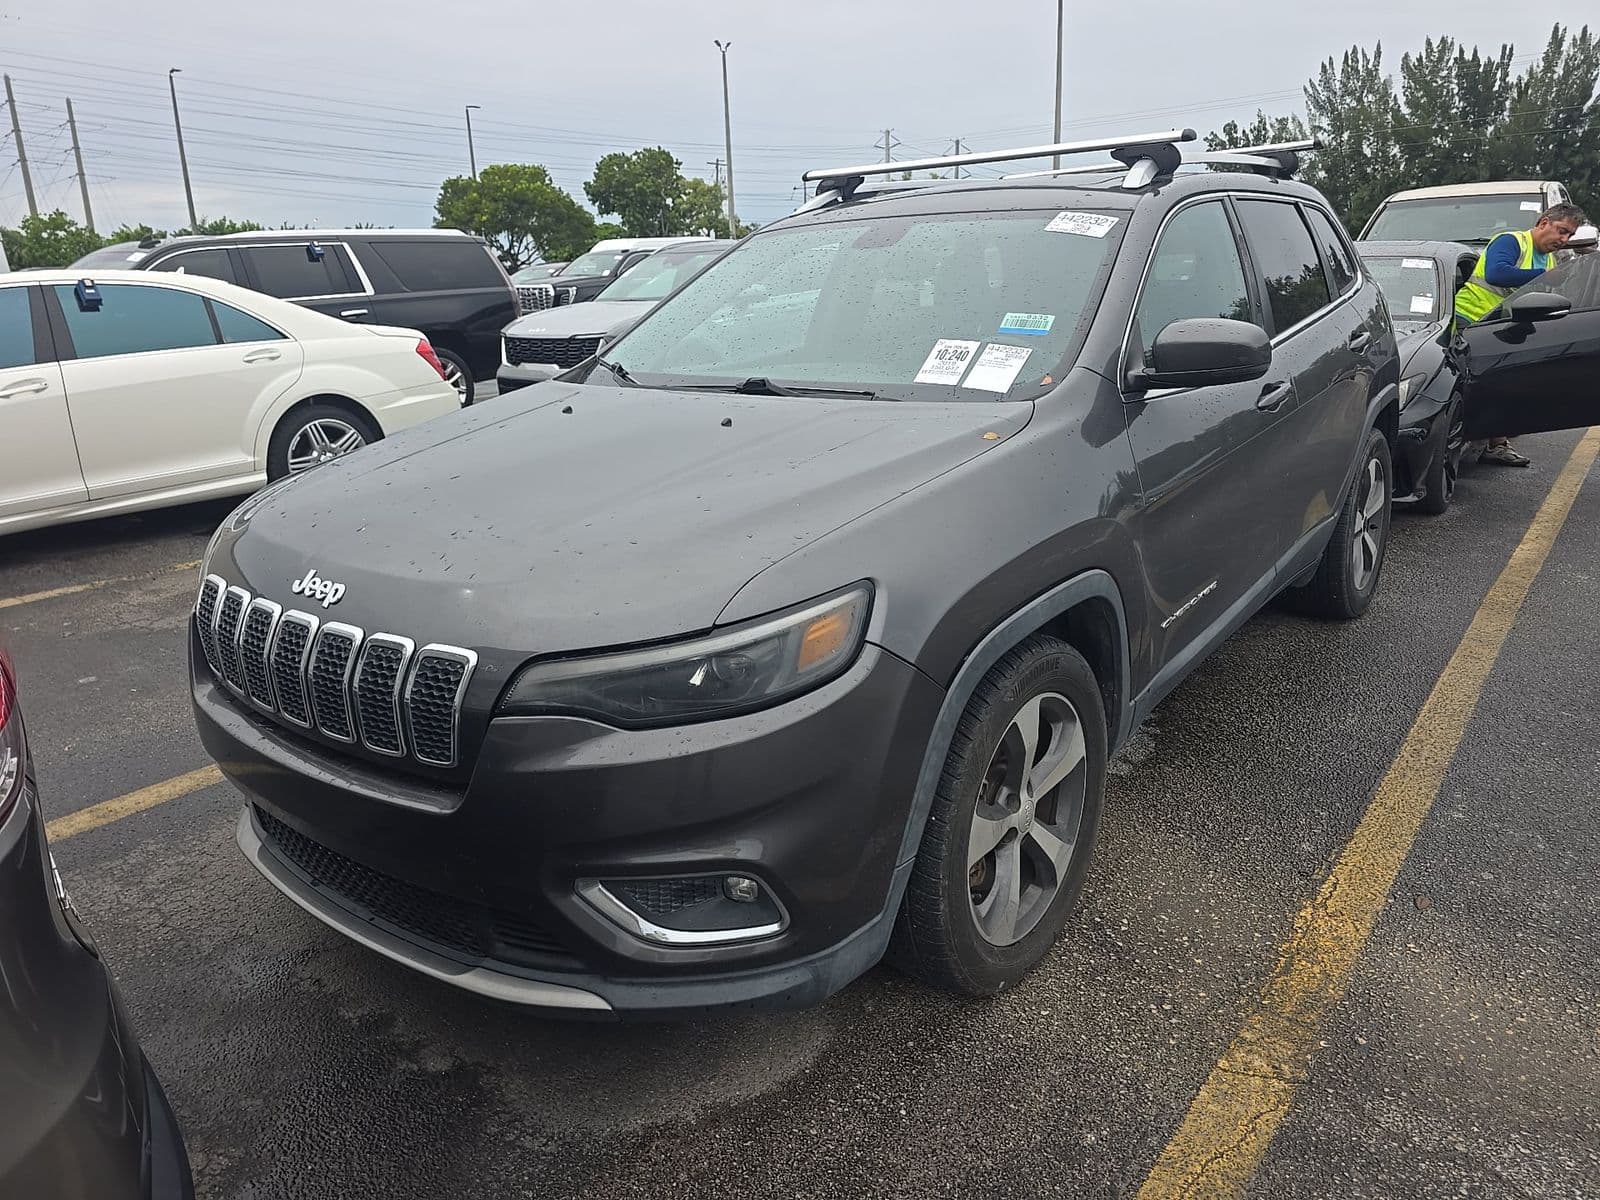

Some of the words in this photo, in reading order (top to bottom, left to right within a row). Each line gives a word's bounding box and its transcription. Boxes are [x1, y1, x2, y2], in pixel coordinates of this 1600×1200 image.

[1058, 213, 1115, 228] 4422321
[934, 349, 970, 362] 10:240
[292, 568, 346, 609] Jeep
